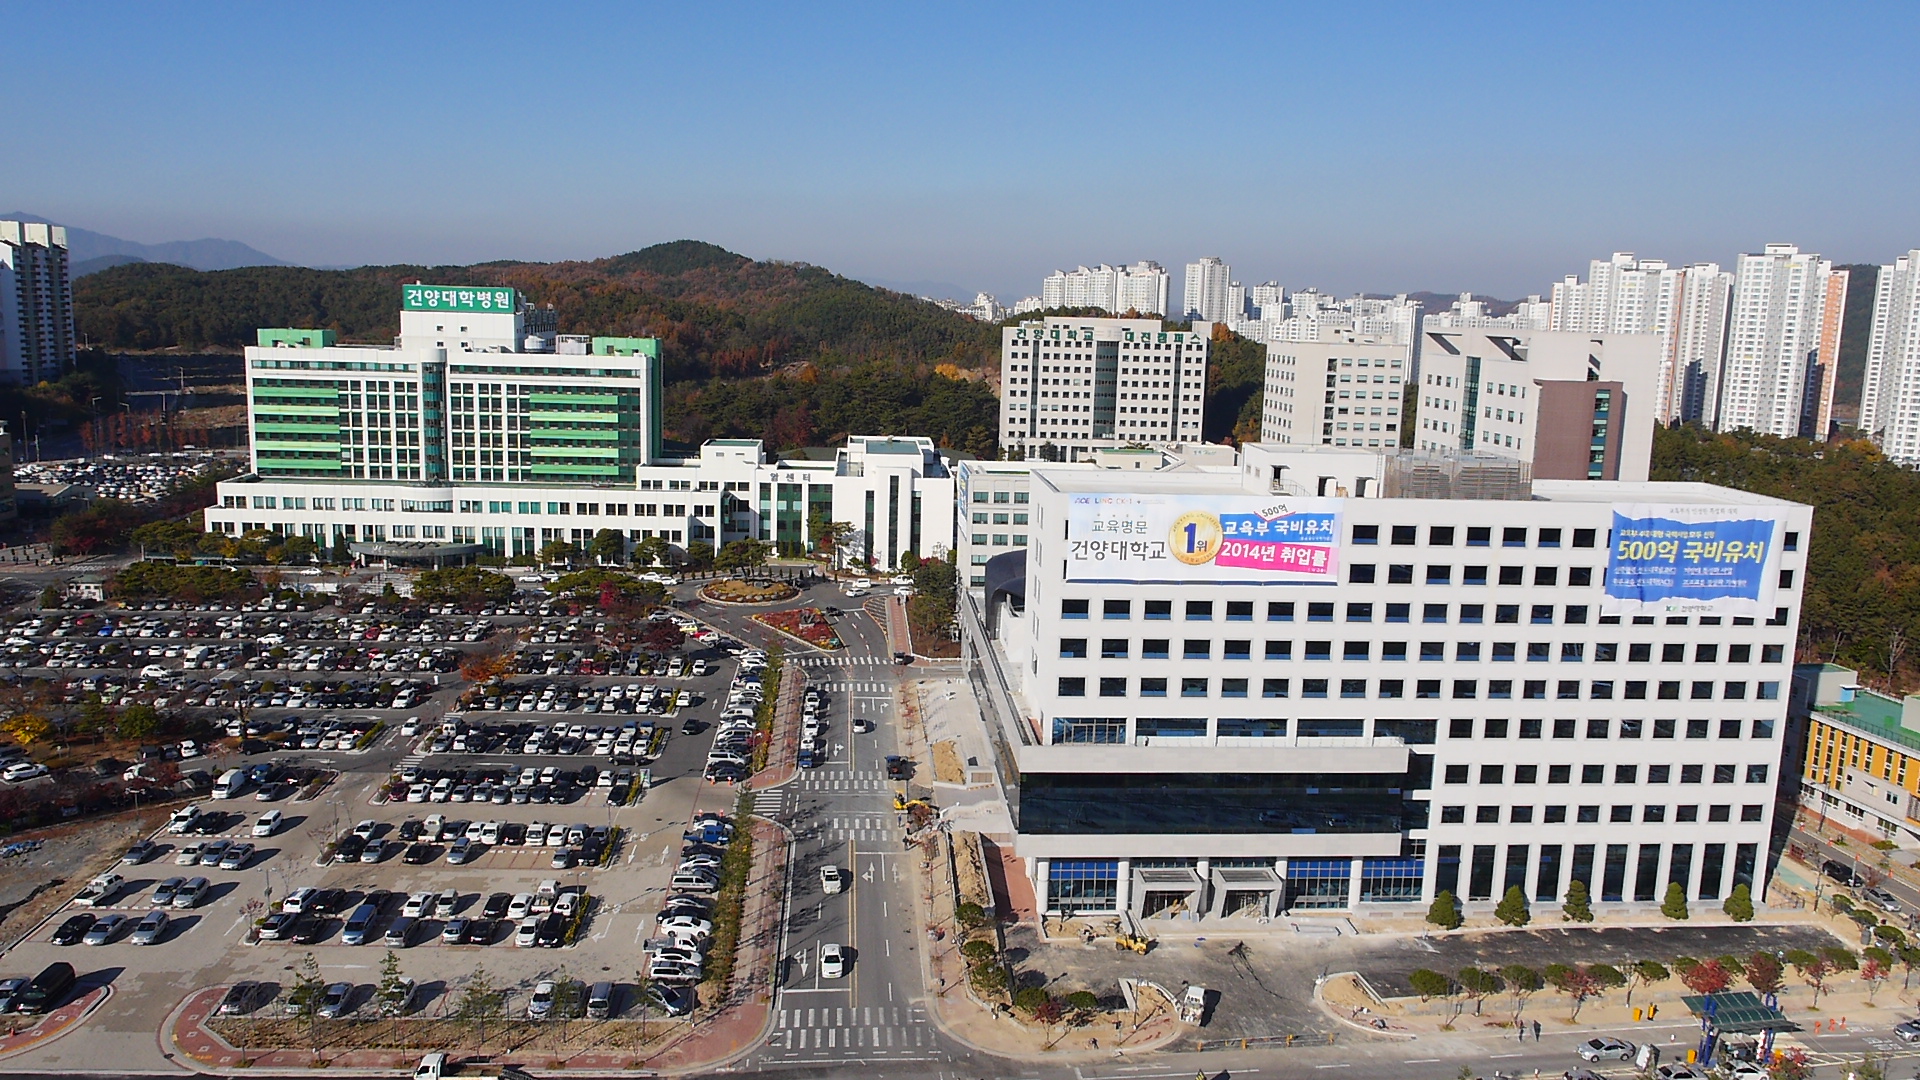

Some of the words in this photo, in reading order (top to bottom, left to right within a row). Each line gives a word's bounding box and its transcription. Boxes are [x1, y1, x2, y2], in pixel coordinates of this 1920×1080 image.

[407, 289, 509, 309] 건양대학병원
[1016, 328, 1094, 341] 건양대학교
[1261, 503, 1288, 517] 500억
[1091, 519, 1148, 535] 교육명문
[1223, 520, 1270, 536] 교육부
[1274, 519, 1335, 536] 국비유치
[1071, 540, 1167, 562] 건양대학교
[1221, 541, 1276, 562] 2014년
[1617, 540, 1680, 564] 500억
[1682, 540, 1765, 564] 국비유치
